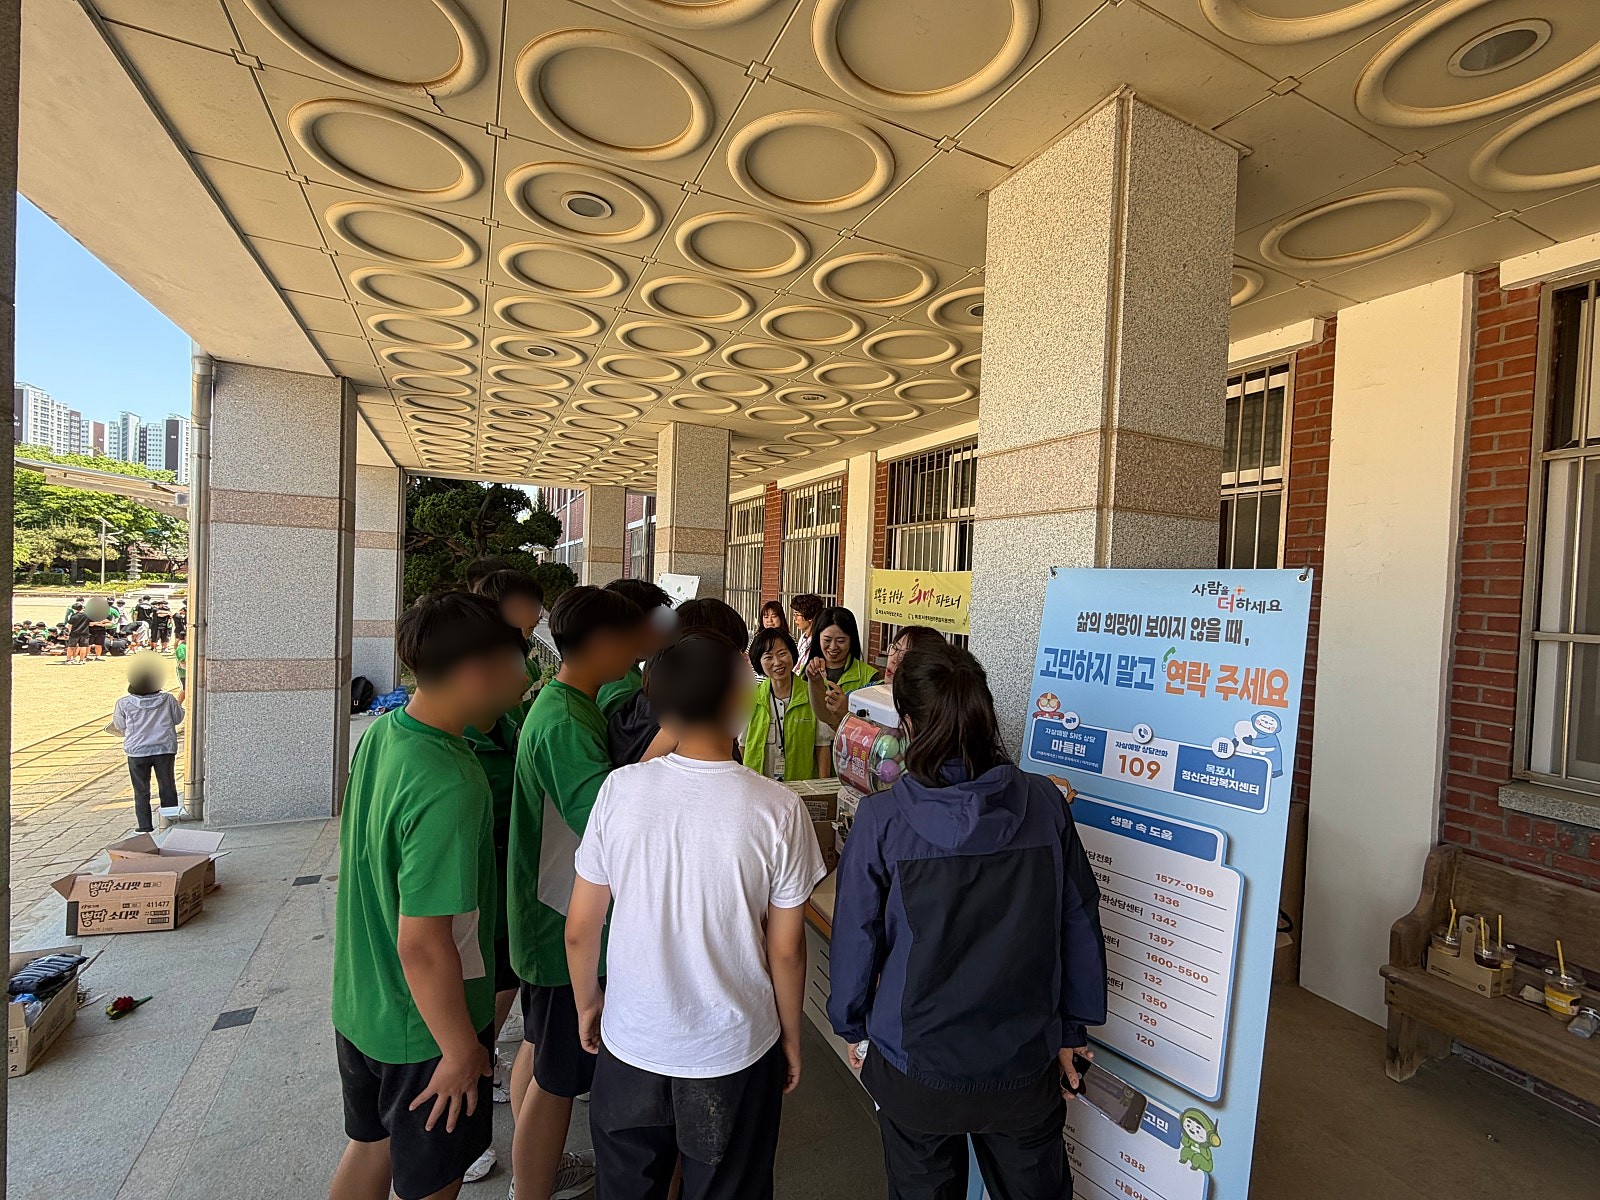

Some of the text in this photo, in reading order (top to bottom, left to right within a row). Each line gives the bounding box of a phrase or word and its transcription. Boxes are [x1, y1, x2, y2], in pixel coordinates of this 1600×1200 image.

[1192, 581, 1230, 596] 사람을
[889, 588, 904, 605] 위한
[935, 594, 962, 610] 파트너
[1218, 595, 1283, 614] 더하세요
[1076, 611, 1250, 647] 삶의 희망이 보이지 않을 때,
[1039, 647, 1289, 709] 고민하지 말고 연락 주세요
[1069, 731, 1083, 741] SNS
[1083, 735, 1097, 744] 상담
[1115, 741, 1169, 758] 자살예방 상담전화
[1118, 754, 1161, 780] 109
[1205, 763, 1236, 779] 목포시
[1181, 769, 1260, 796] 정신건강복지센터
[1110, 815, 1173, 842] 생활 속 도움
[89, 880, 114, 897] 뽕따
[113, 881, 141, 891] 소다맛
[1155, 872, 1215, 899] 1577-0199
[1152, 892, 1181, 908] 1336
[81, 908, 108, 927] 뽕따
[108, 910, 140, 921] 소다맛
[1100, 892, 1178, 929] 화상담센터 1342
[1148, 932, 1176, 948] 1397
[1145, 952, 1209, 985] 1600-5500
[1143, 972, 1163, 987] 132
[1140, 992, 1168, 1010] 1350
[1138, 1012, 1157, 1027] 129
[1135, 1032, 1155, 1048] 120
[1119, 1151, 1147, 1173] 1388
